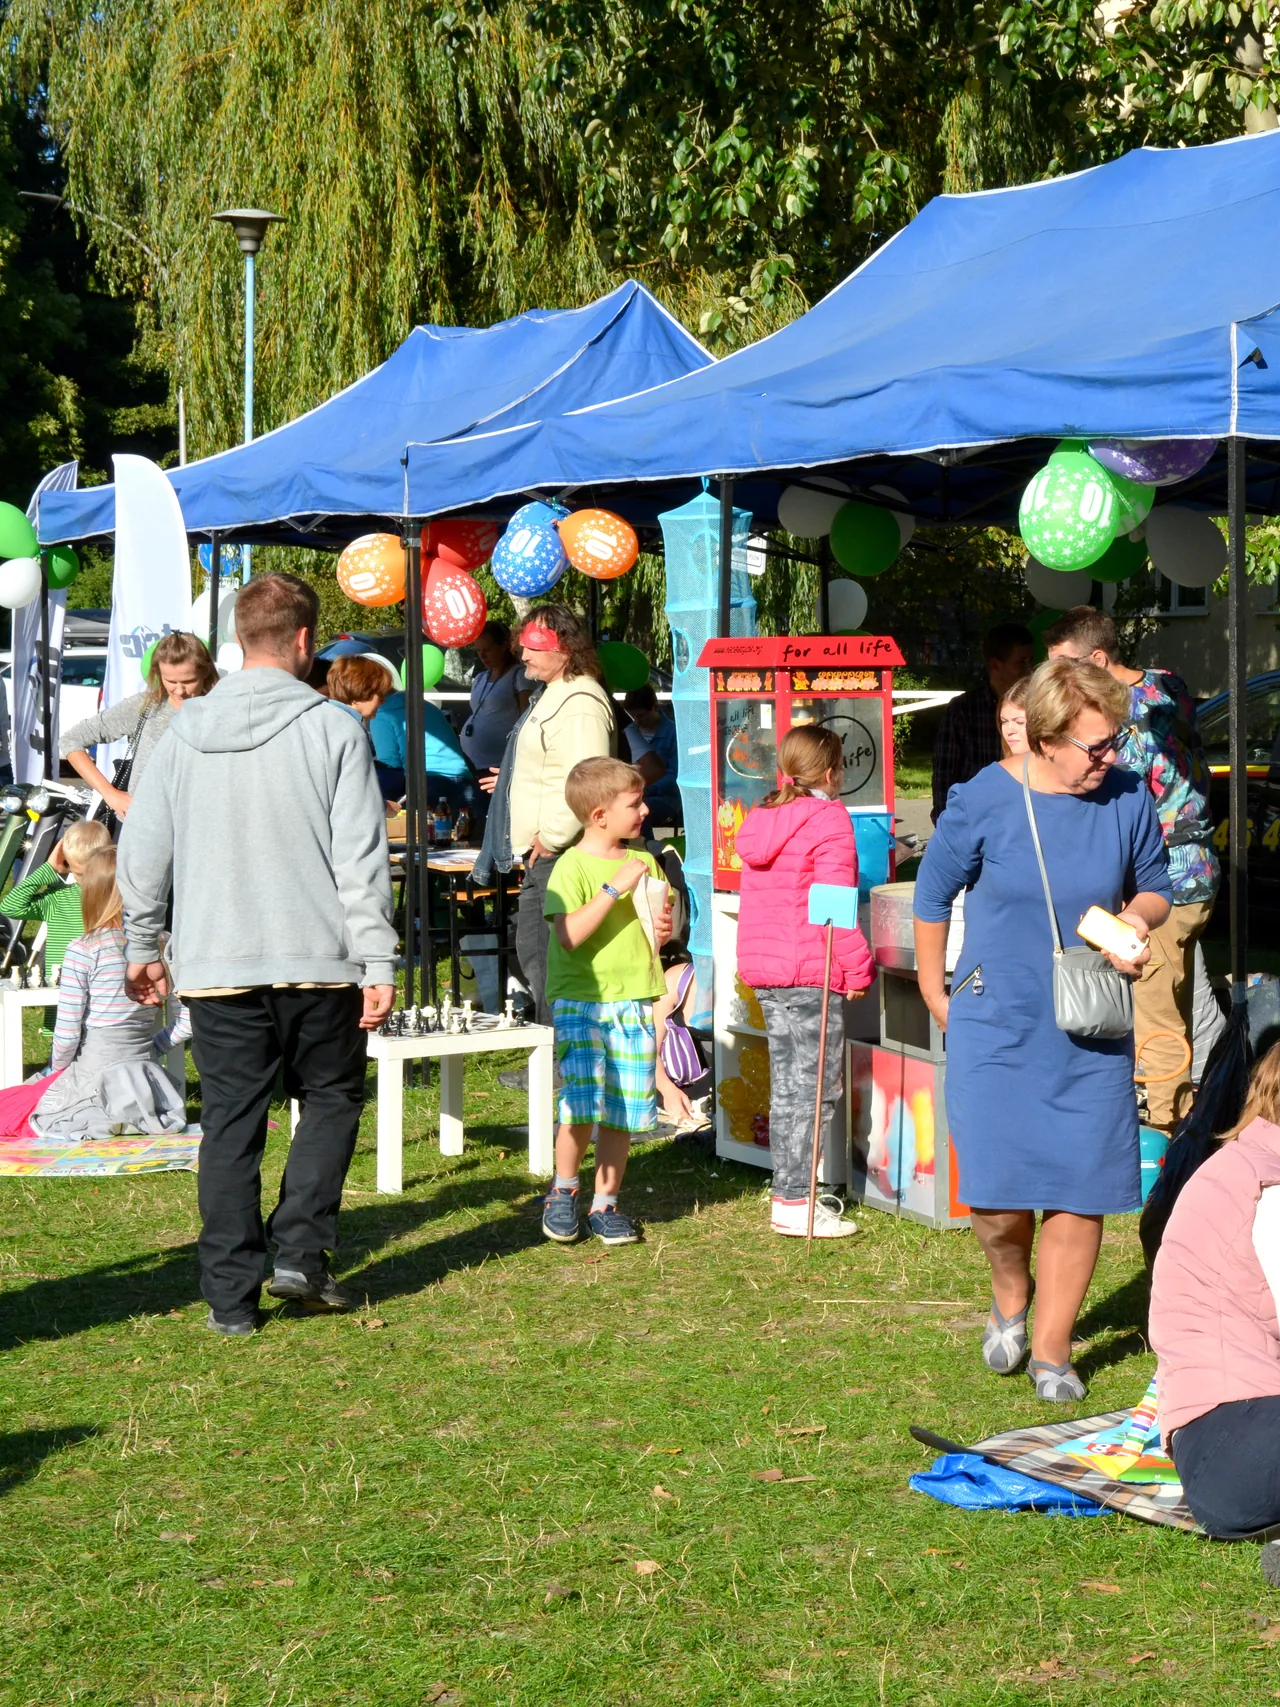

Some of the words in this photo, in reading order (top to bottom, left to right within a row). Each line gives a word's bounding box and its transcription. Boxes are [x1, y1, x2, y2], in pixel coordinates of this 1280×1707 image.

[1079, 482, 1114, 529] 10
[508, 529, 543, 558] 10
[584, 528, 618, 561] 10
[349, 571, 383, 601] 10
[444, 585, 477, 620] 10
[783, 645, 811, 662] for
[823, 643, 847, 656] all
[859, 640, 893, 655] life
